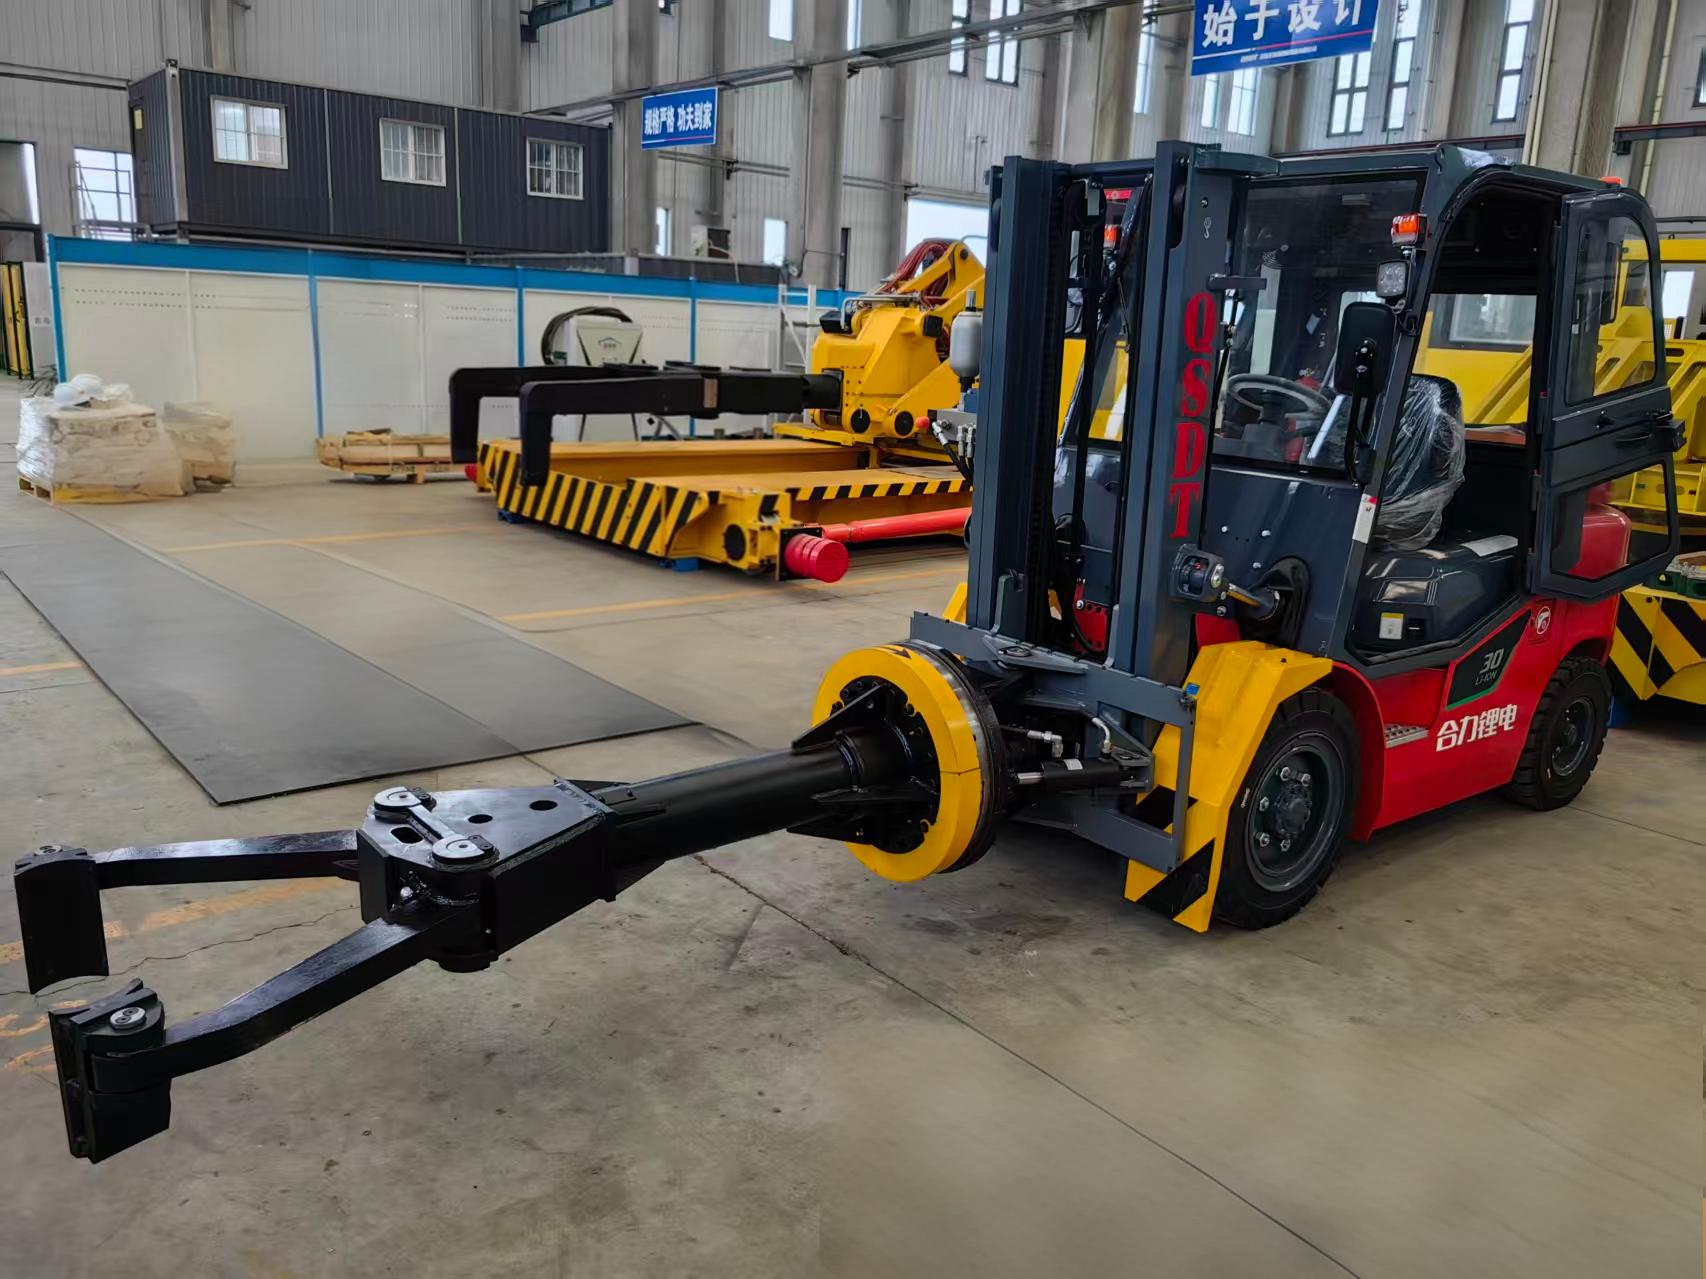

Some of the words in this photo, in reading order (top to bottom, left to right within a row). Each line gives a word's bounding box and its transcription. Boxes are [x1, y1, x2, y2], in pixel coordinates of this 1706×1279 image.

[677, 100, 713, 132] 功夫到家
[1168, 292, 1217, 539] QSDT
[1479, 648, 1505, 674] 30
[1436, 703, 1518, 752] 合力锂电
